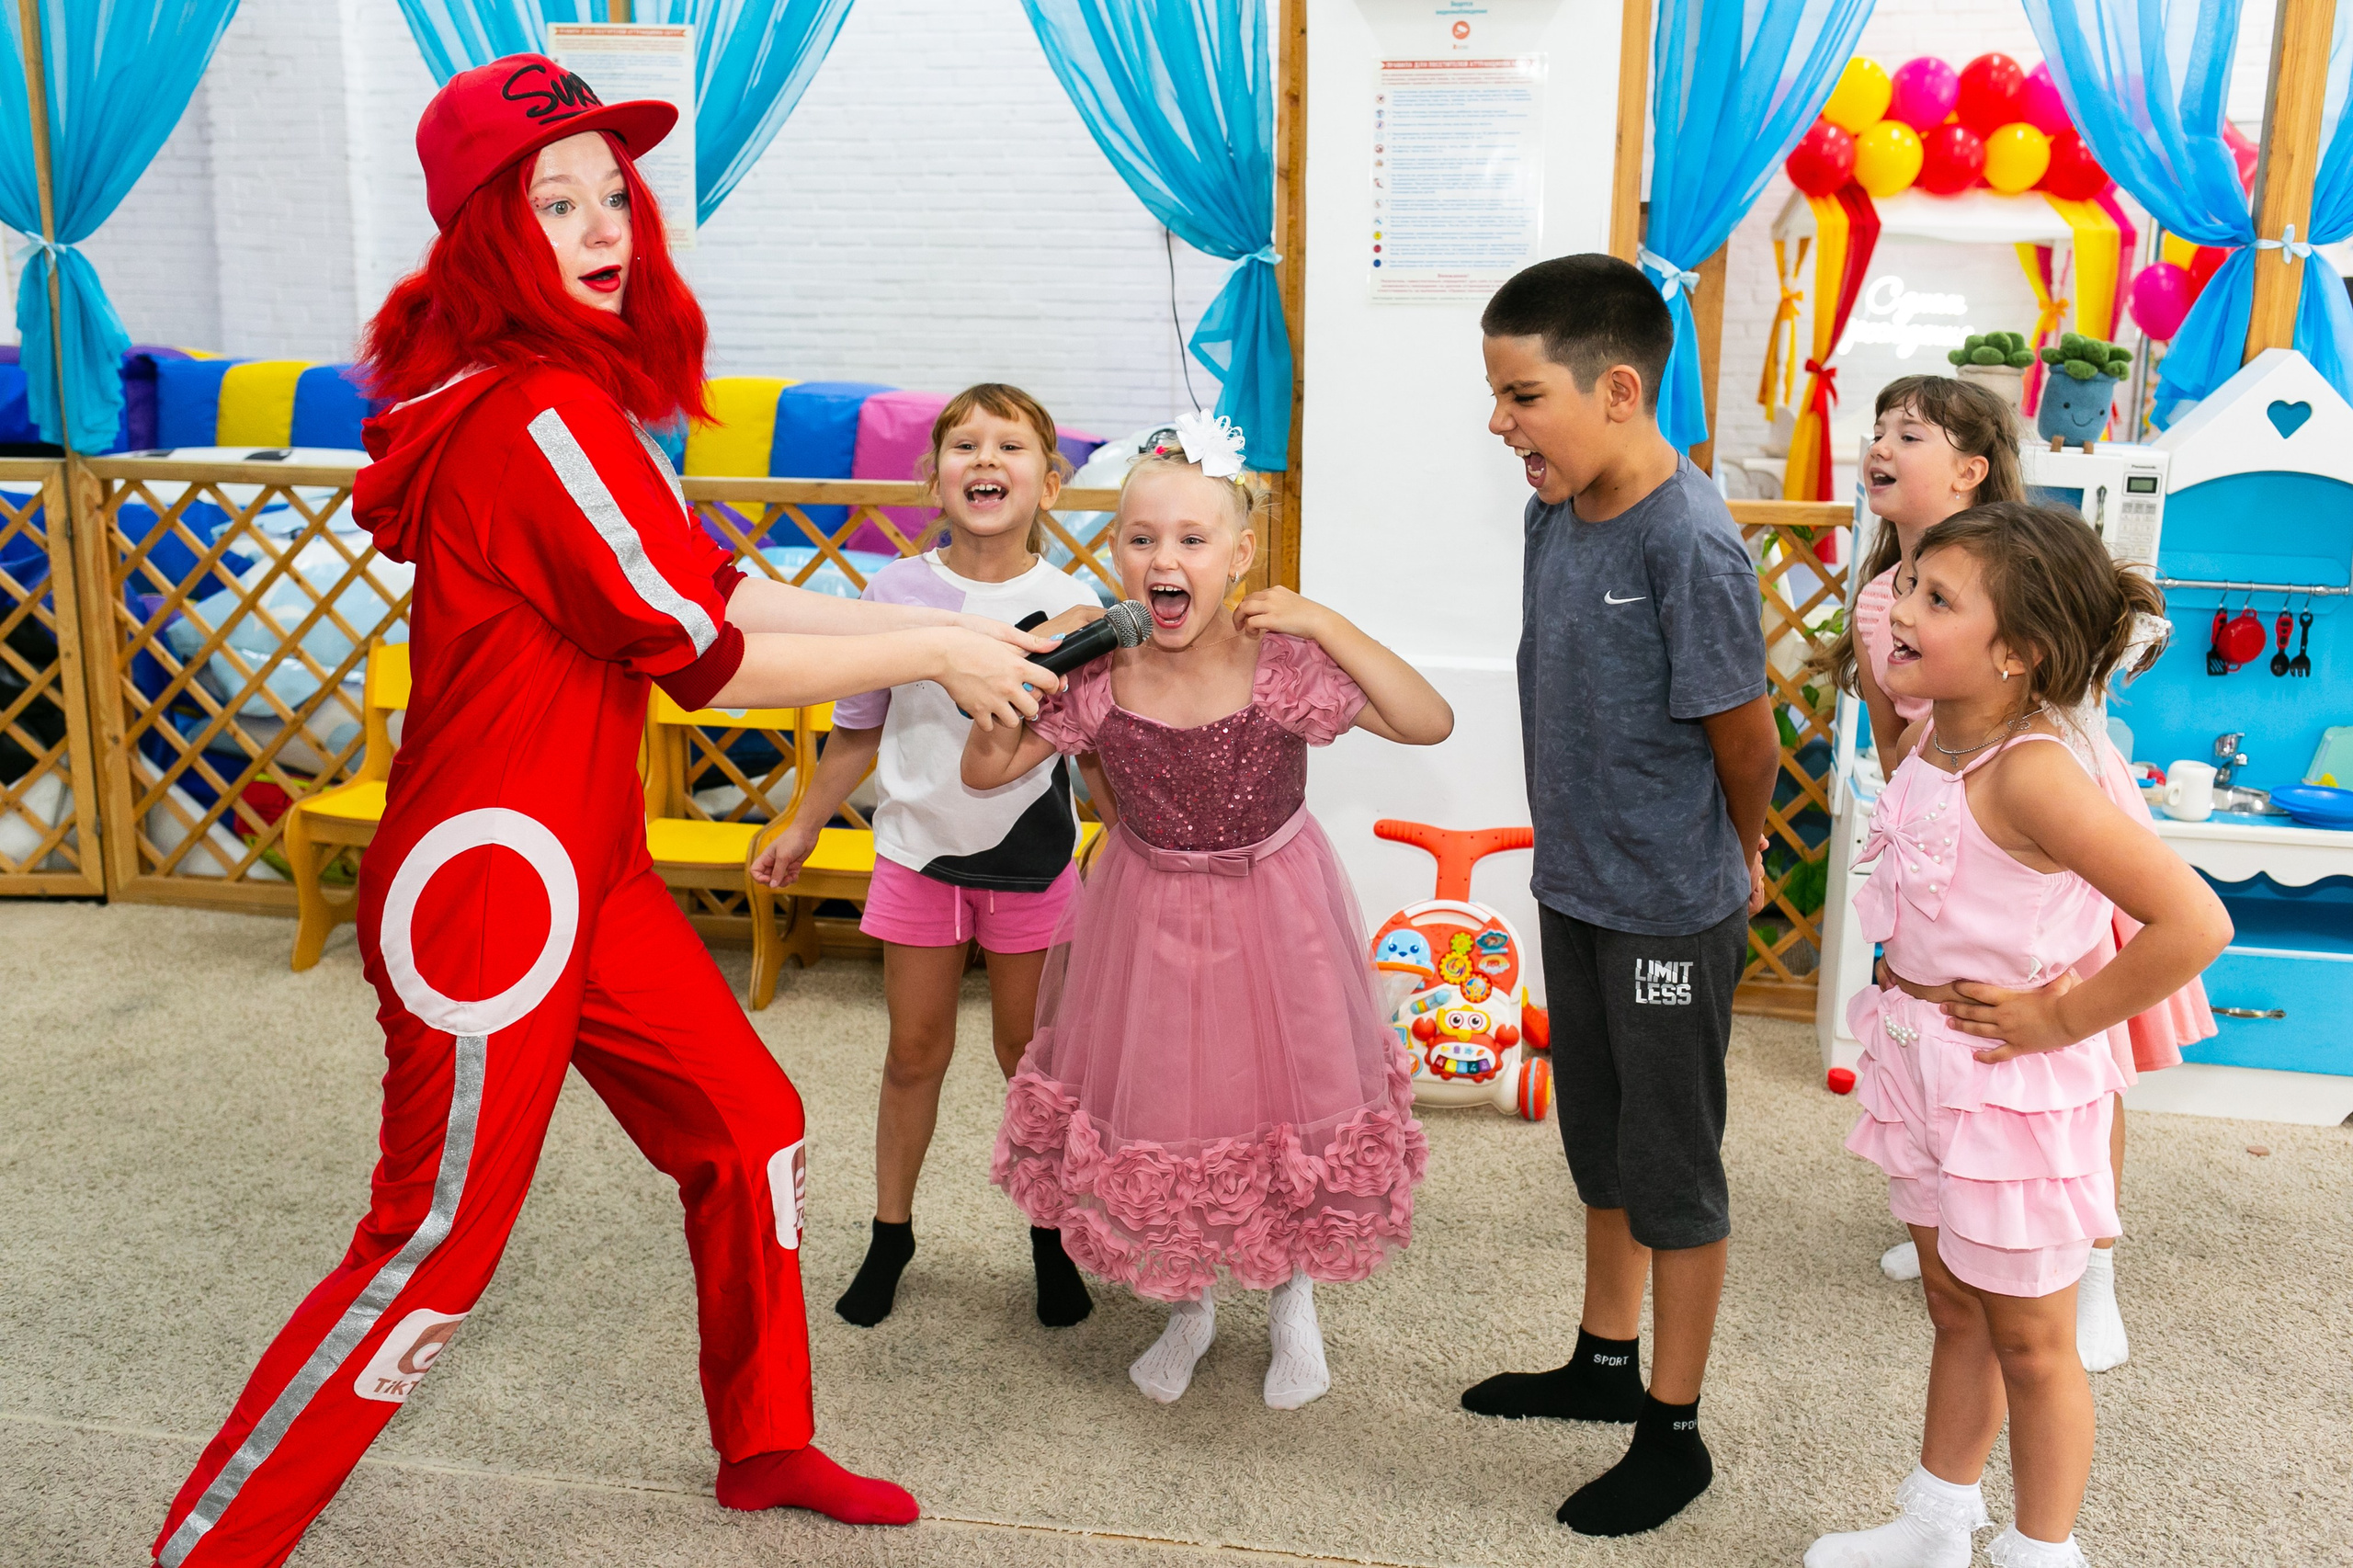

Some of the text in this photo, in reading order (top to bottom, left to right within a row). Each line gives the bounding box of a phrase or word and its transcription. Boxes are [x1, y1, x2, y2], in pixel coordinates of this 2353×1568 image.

[1635, 959, 1694, 983] LIMIT
[1635, 981, 1691, 1005] LESS
[1593, 1354, 1629, 1366] SPORT
